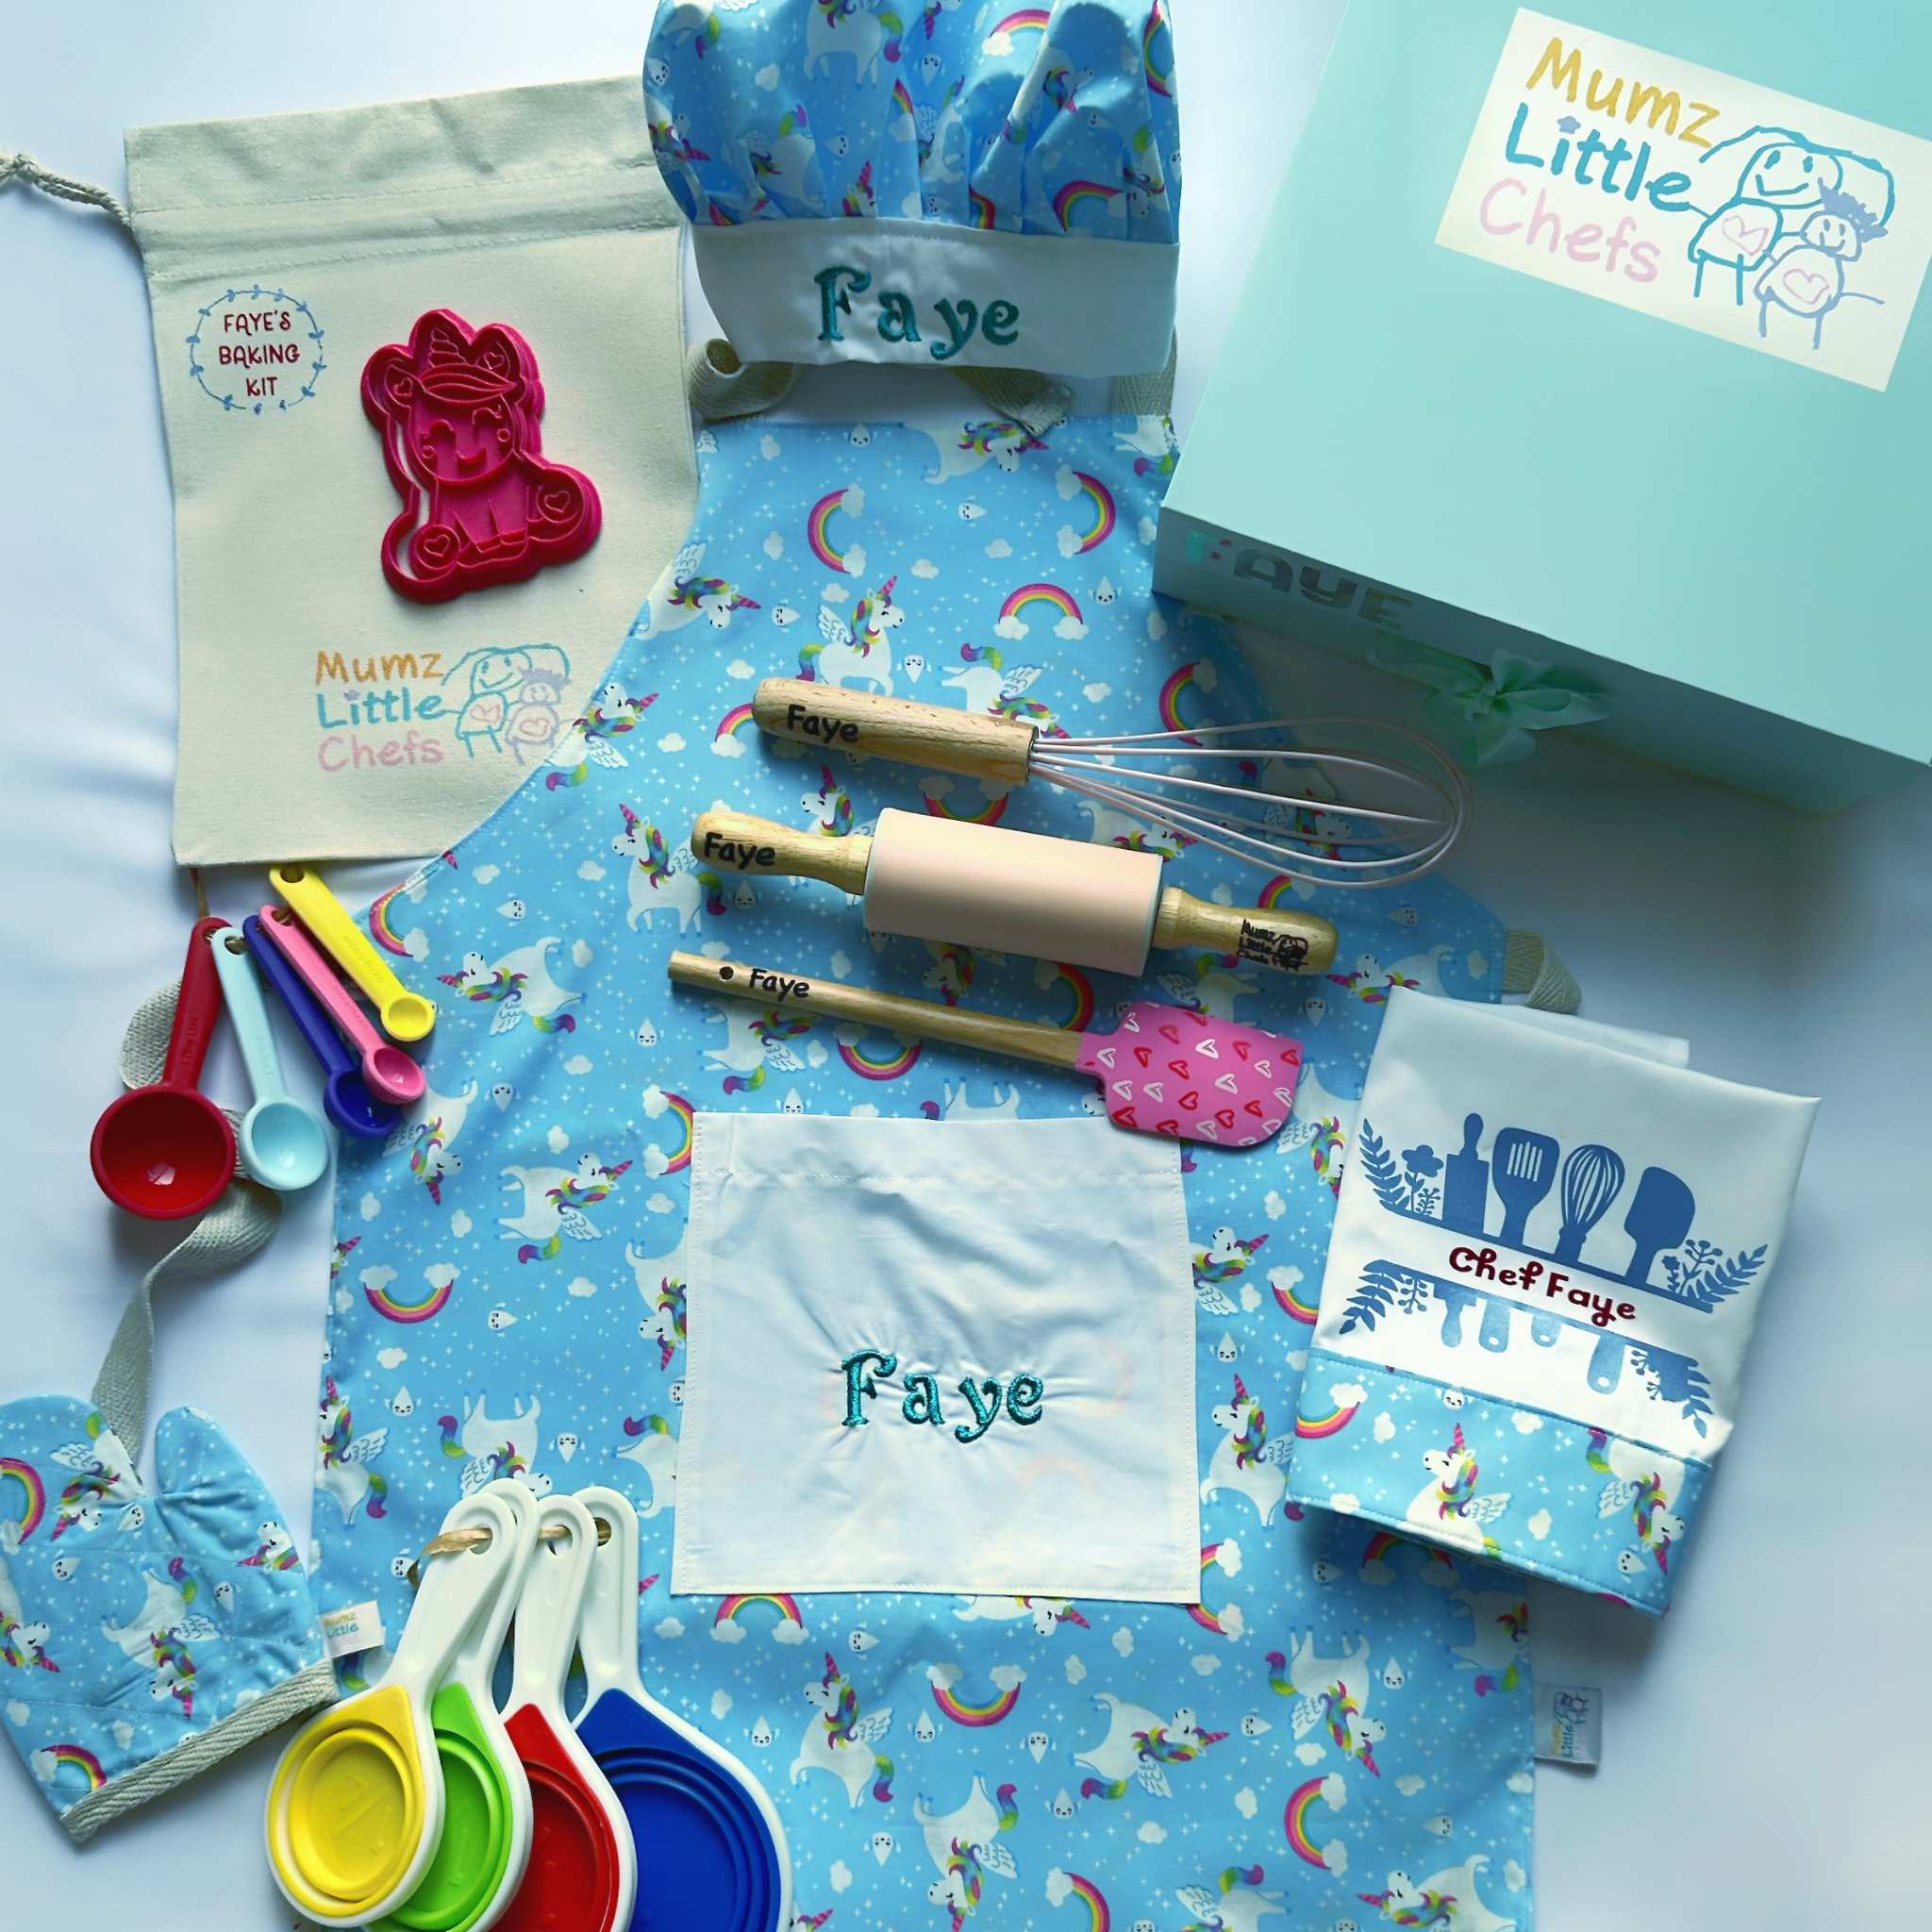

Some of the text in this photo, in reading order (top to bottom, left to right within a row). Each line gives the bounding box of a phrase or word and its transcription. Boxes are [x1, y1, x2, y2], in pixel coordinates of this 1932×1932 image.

[1525, 37, 1720, 148] Mumz
[1506, 102, 1691, 211] Little
[1479, 177, 1660, 283] Chefs
[224, 311, 291, 336] FAYE'S
[814, 265, 1020, 360] Faye
[218, 343, 301, 368] BAKING
[245, 376, 277, 397] KIT
[315, 649, 445, 686] Mumz
[316, 686, 447, 729] Little
[786, 704, 859, 743] Faye
[317, 729, 444, 772] Chefs
[704, 832, 775, 870] Faye
[749, 968, 810, 1002] Faye
[1449, 1246, 1637, 1327] Chef Faye
[841, 1349, 1044, 1444] Faye
